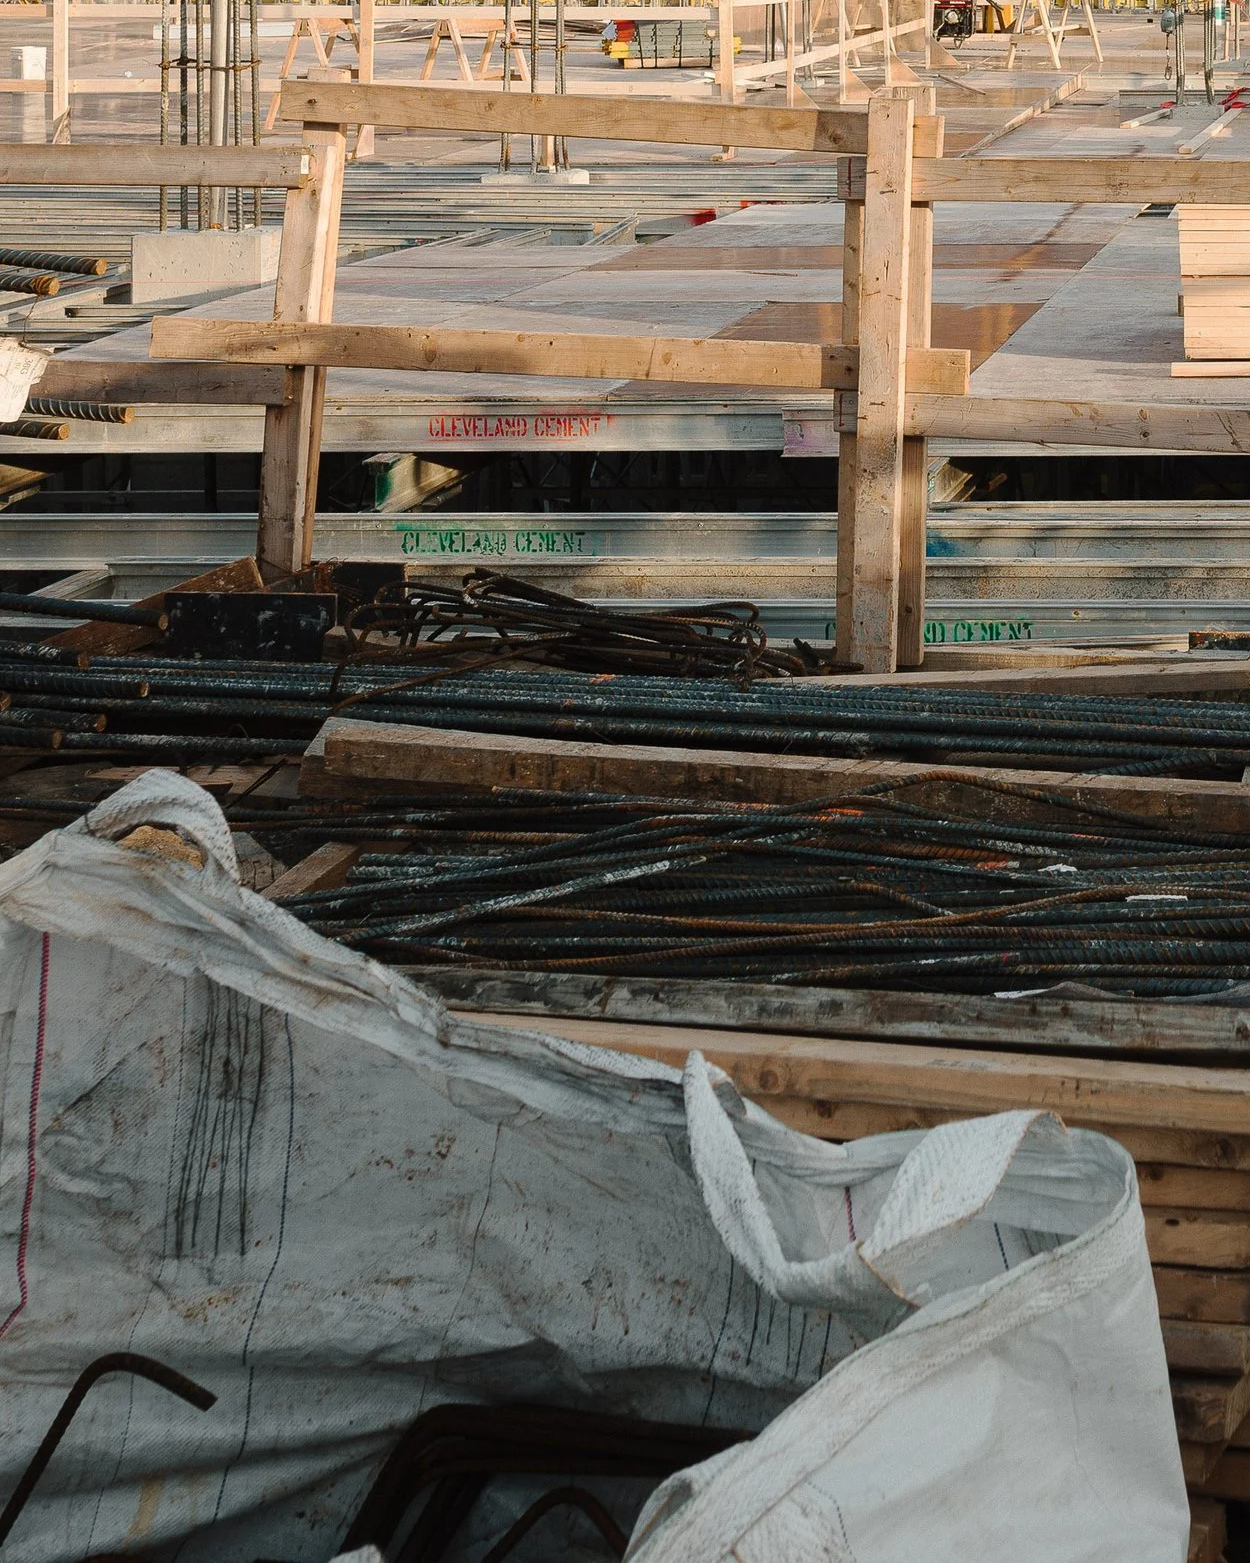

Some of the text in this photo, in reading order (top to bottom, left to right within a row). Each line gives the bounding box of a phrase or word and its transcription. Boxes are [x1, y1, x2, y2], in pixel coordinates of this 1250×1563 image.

[428, 415, 601, 437] CLEVELAND CEMENT
[401, 531, 586, 554] CLEVELAND CEMENT
[953, 621, 1035, 643] CEMENT
